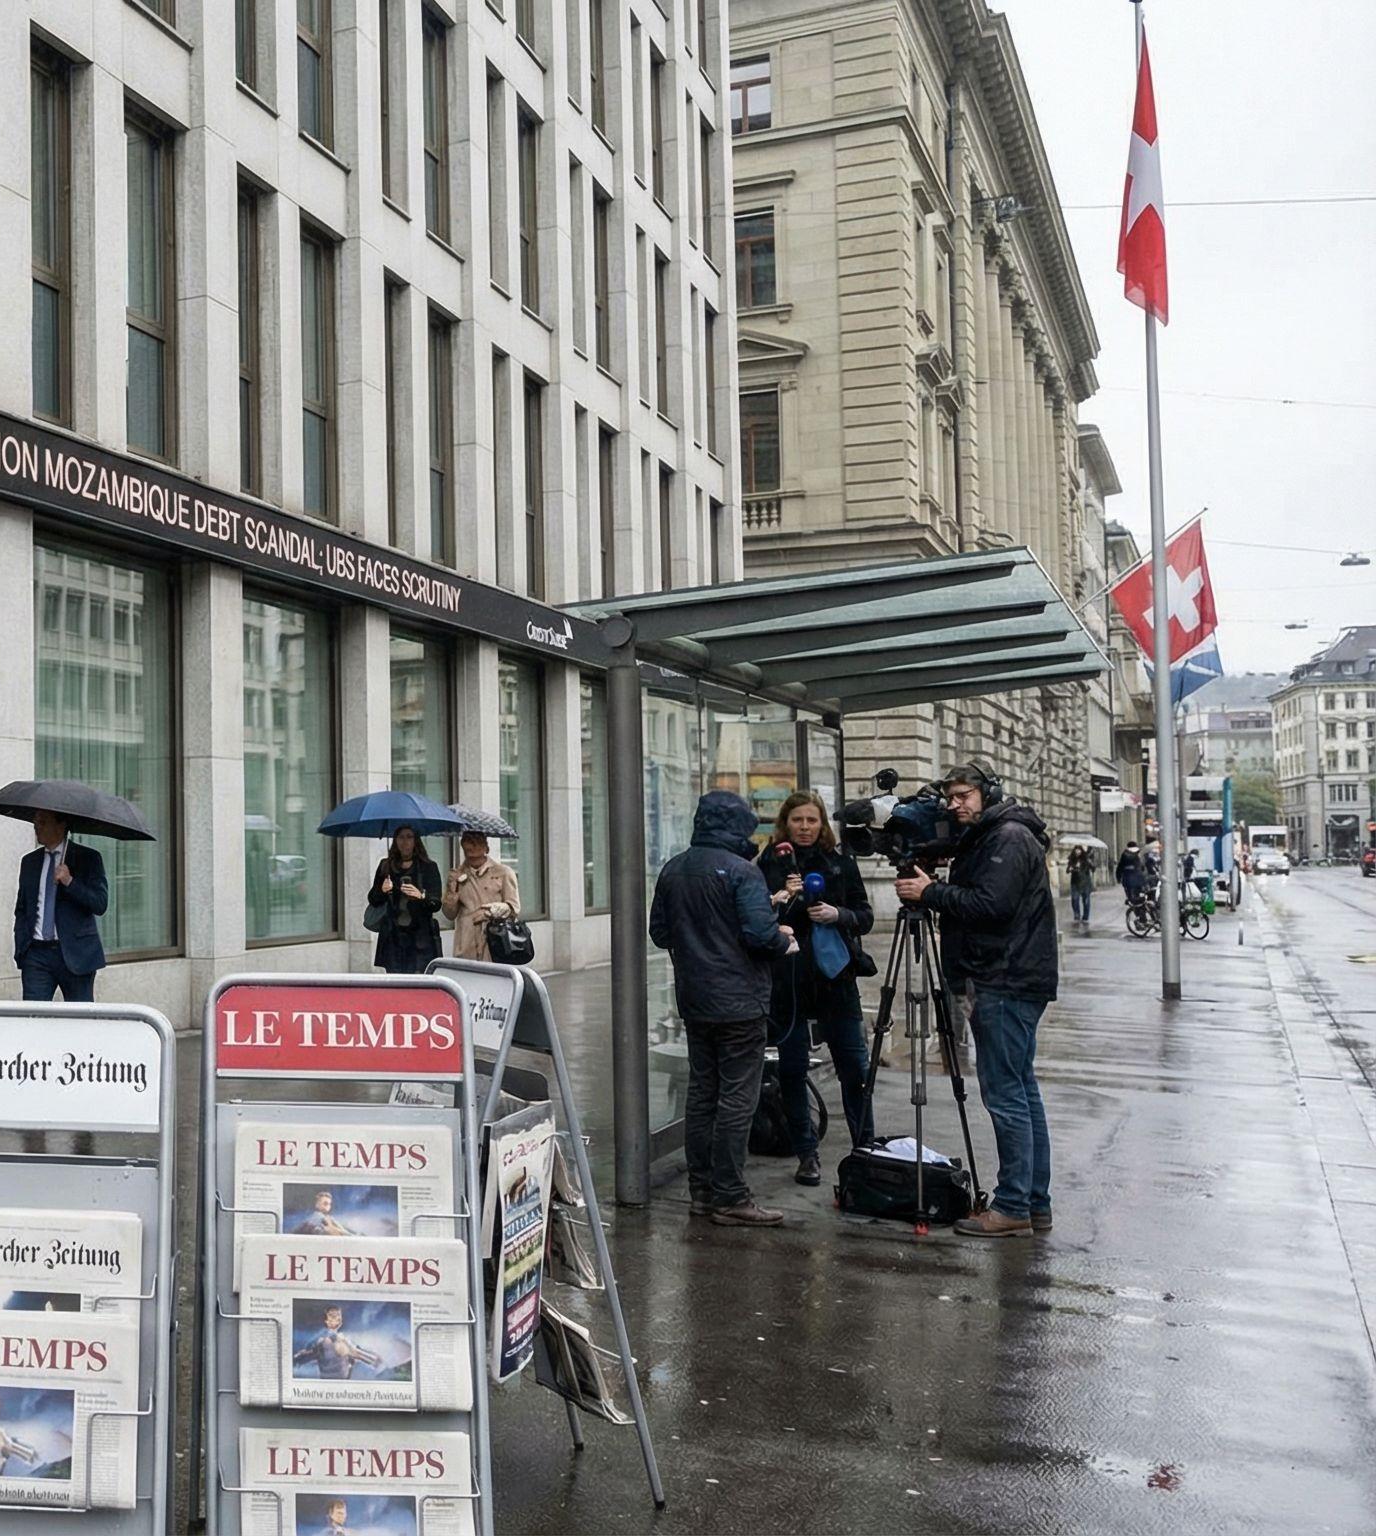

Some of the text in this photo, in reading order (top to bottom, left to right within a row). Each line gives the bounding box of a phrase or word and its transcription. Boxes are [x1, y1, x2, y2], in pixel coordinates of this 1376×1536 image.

[45, 448, 191, 530] MOZAMBIQUE
[194, 499, 242, 547] DEBT
[244, 516, 323, 576] SCANDAL;
[326, 543, 356, 581] UBS
[357, 554, 400, 595] FACES
[401, 569, 462, 613] SCRUTINY
[222, 1010, 455, 1050] LE TEMPS
[56, 1053, 147, 1092] Zeitung
[256, 1139, 428, 1170] LE TEMPS
[45, 1239, 122, 1273] Zeitung
[265, 1254, 440, 1286] LE TEMPS
[266, 1447, 445, 1479] LE TEMPS
